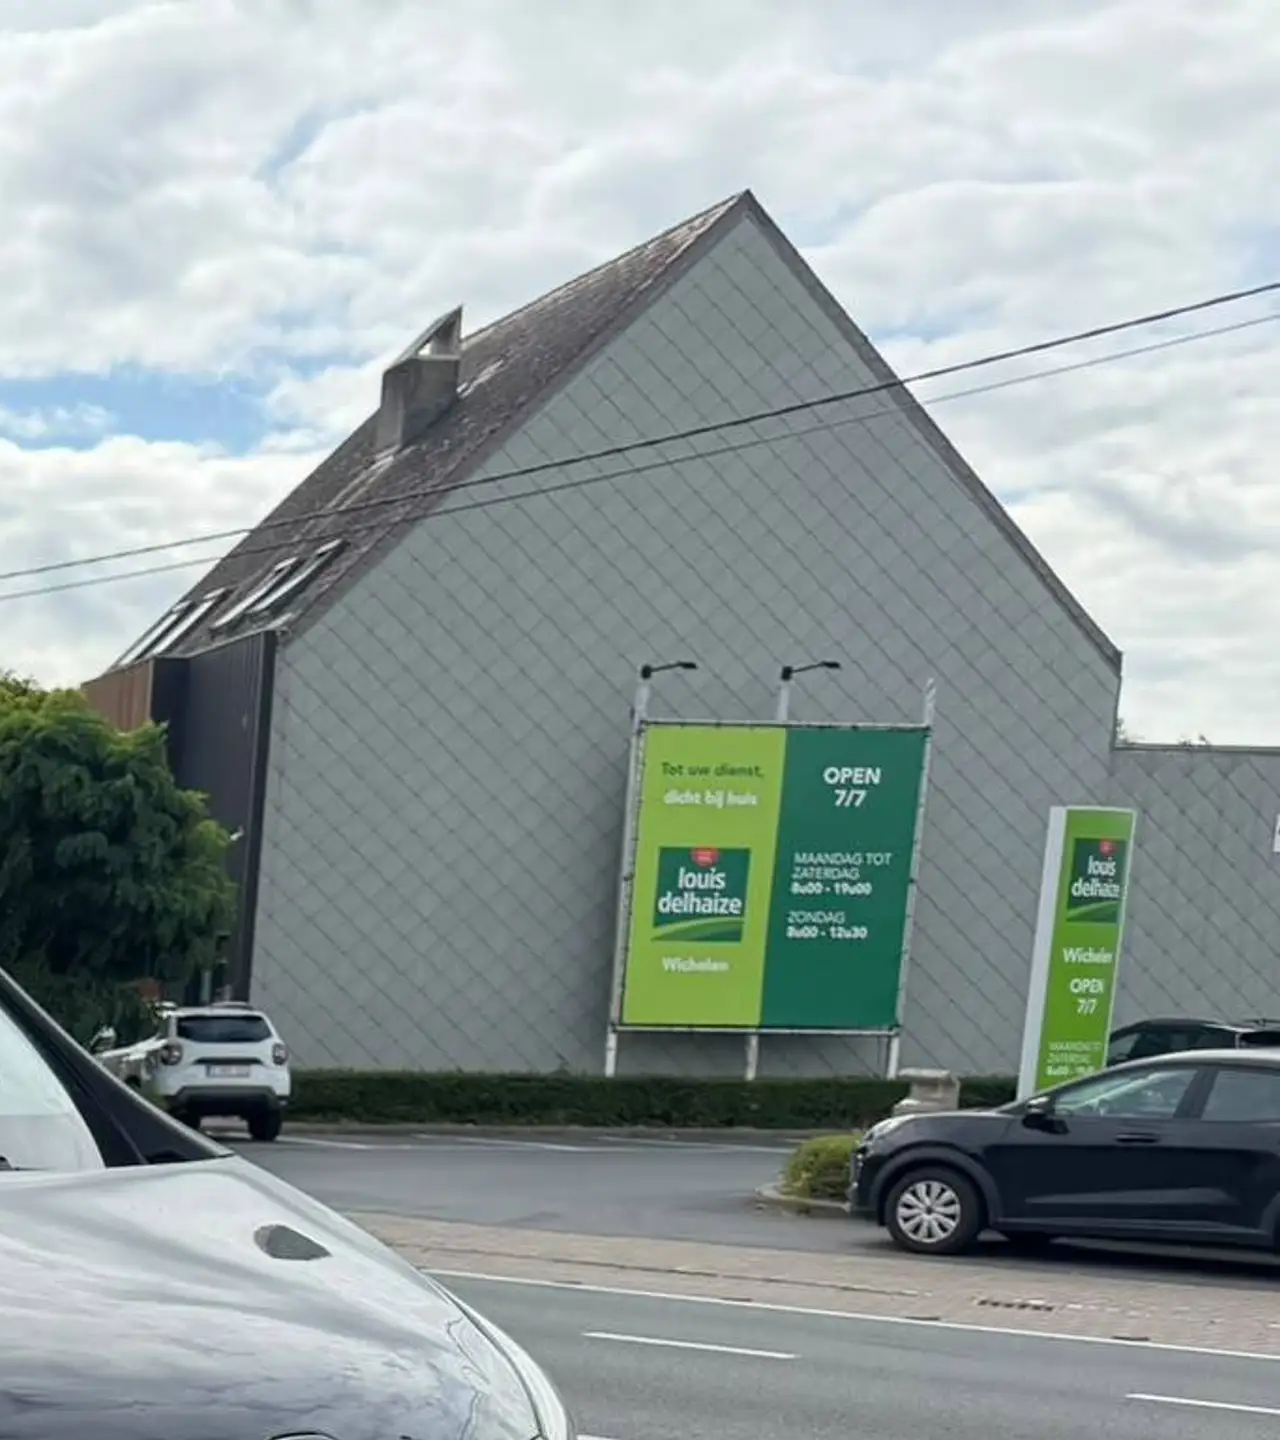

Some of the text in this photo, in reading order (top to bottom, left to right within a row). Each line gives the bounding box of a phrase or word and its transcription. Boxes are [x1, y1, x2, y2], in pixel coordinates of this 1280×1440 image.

[823, 766, 881, 785] OPEN
[834, 789, 867, 808] 7/7
[794, 852, 892, 866] MAANDAG TOT
[1088, 854, 1116, 877] louis
[679, 866, 726, 889] louis
[792, 866, 860, 880] ZATERDAG
[658, 891, 742, 914] delhaize
[787, 910, 845, 924] ZONDAG
[1077, 998, 1098, 1015] 7/7
